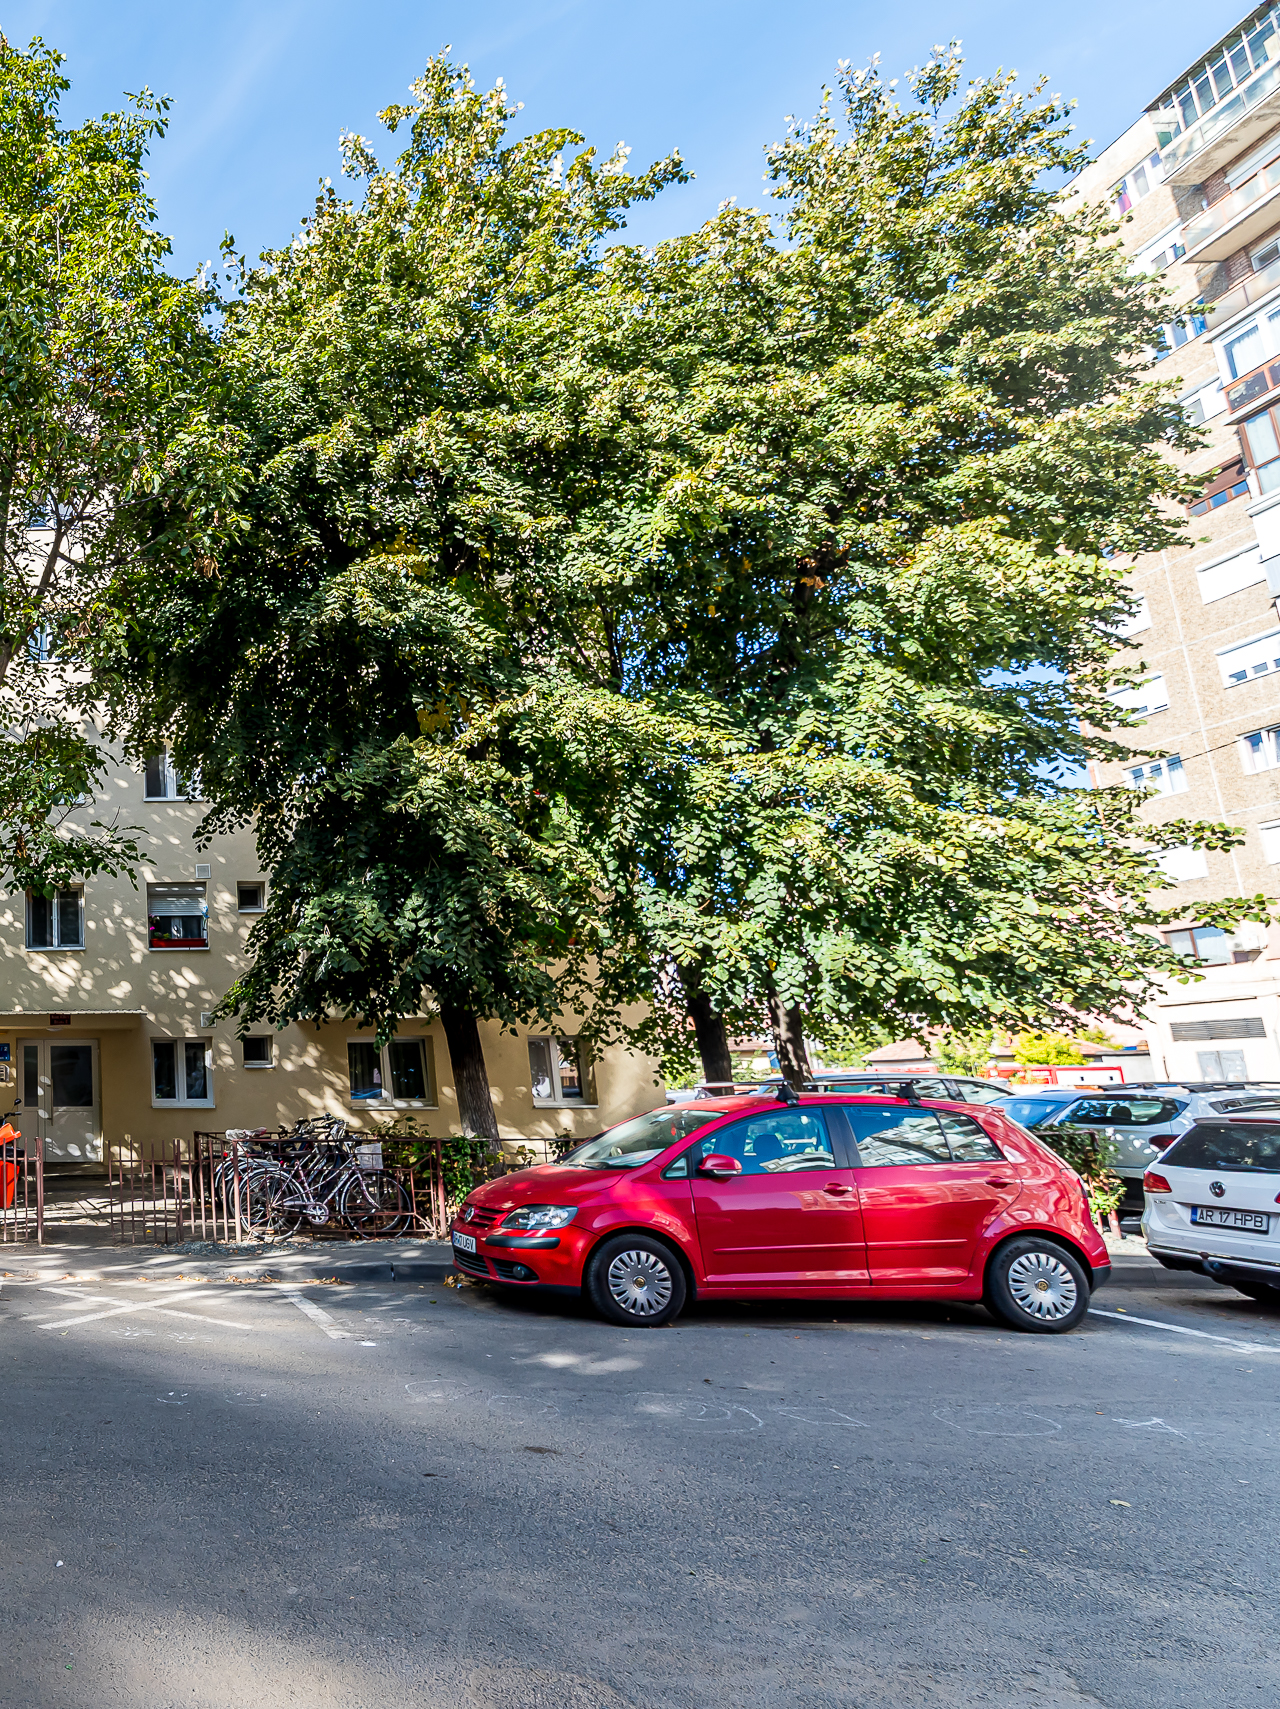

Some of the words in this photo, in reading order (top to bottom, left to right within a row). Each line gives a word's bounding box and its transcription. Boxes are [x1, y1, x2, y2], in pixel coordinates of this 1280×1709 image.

[1198, 1209, 1214, 1222] AR
[1218, 1211, 1231, 1223] 17
[1233, 1213, 1263, 1228] HPB
